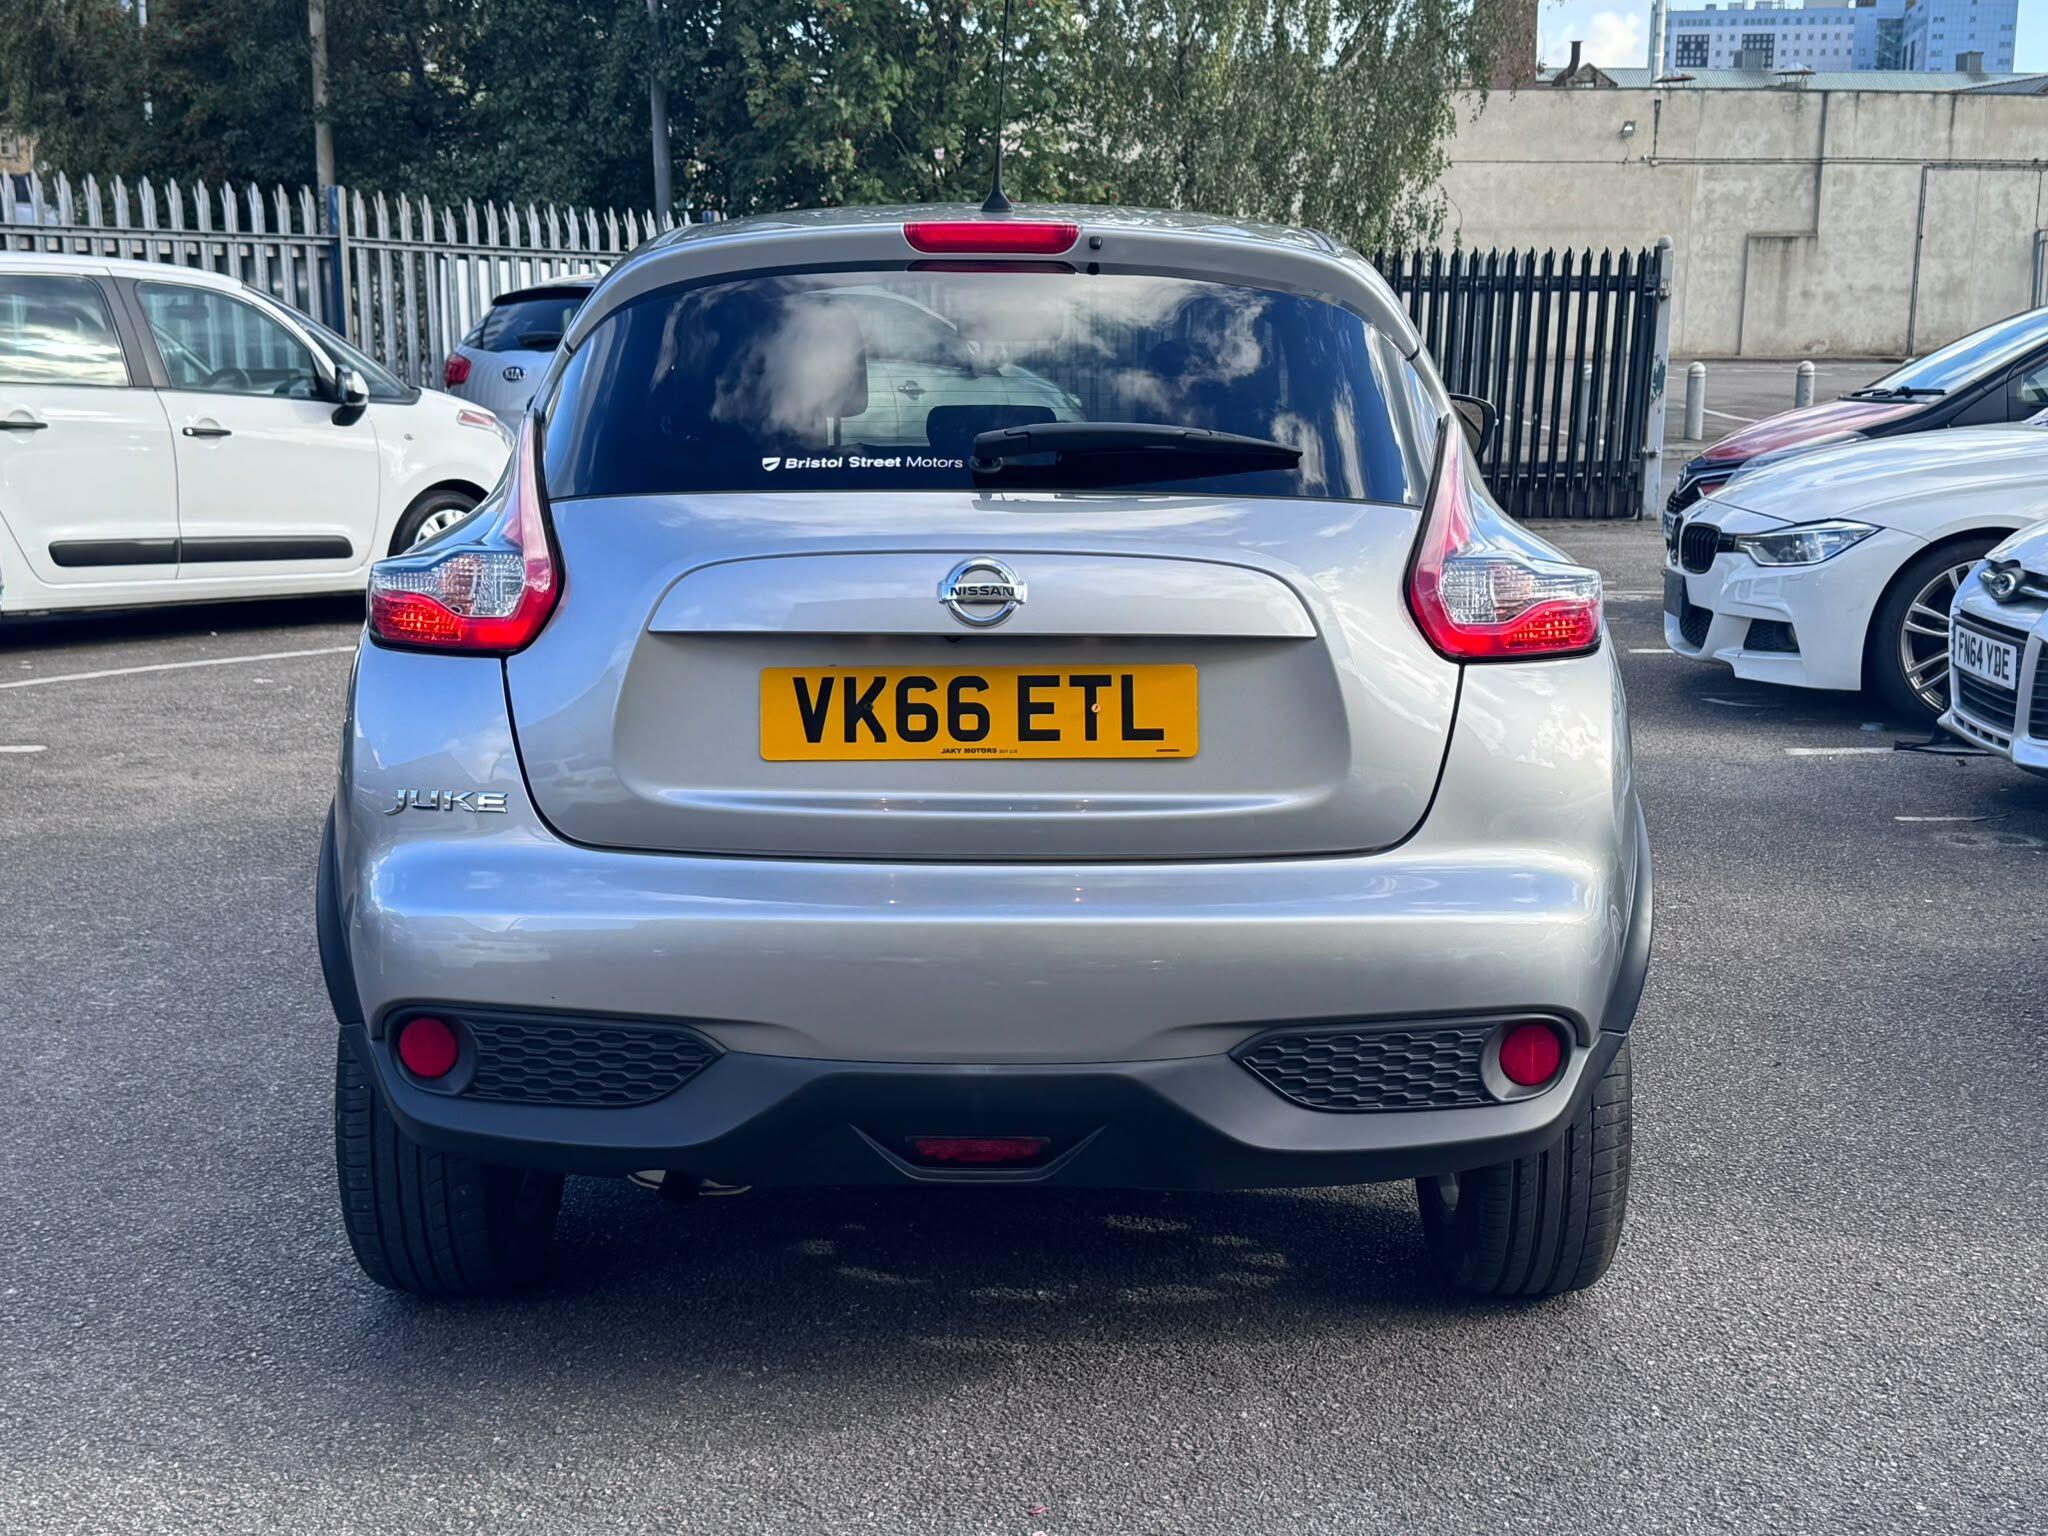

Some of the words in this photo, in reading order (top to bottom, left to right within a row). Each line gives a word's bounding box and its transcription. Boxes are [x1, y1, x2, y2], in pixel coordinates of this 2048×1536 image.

[505, 367, 525, 380] KIA
[785, 457, 843, 469] Bristol
[849, 456, 901, 468] Street
[906, 456, 964, 468] Motors
[950, 585, 1015, 597] NISSAN
[1958, 631, 1984, 671] FN64
[1986, 641, 2011, 681] YDE
[792, 675, 991, 743] VK66
[1017, 674, 1165, 742] ETL
[383, 789, 509, 816] JUKE
